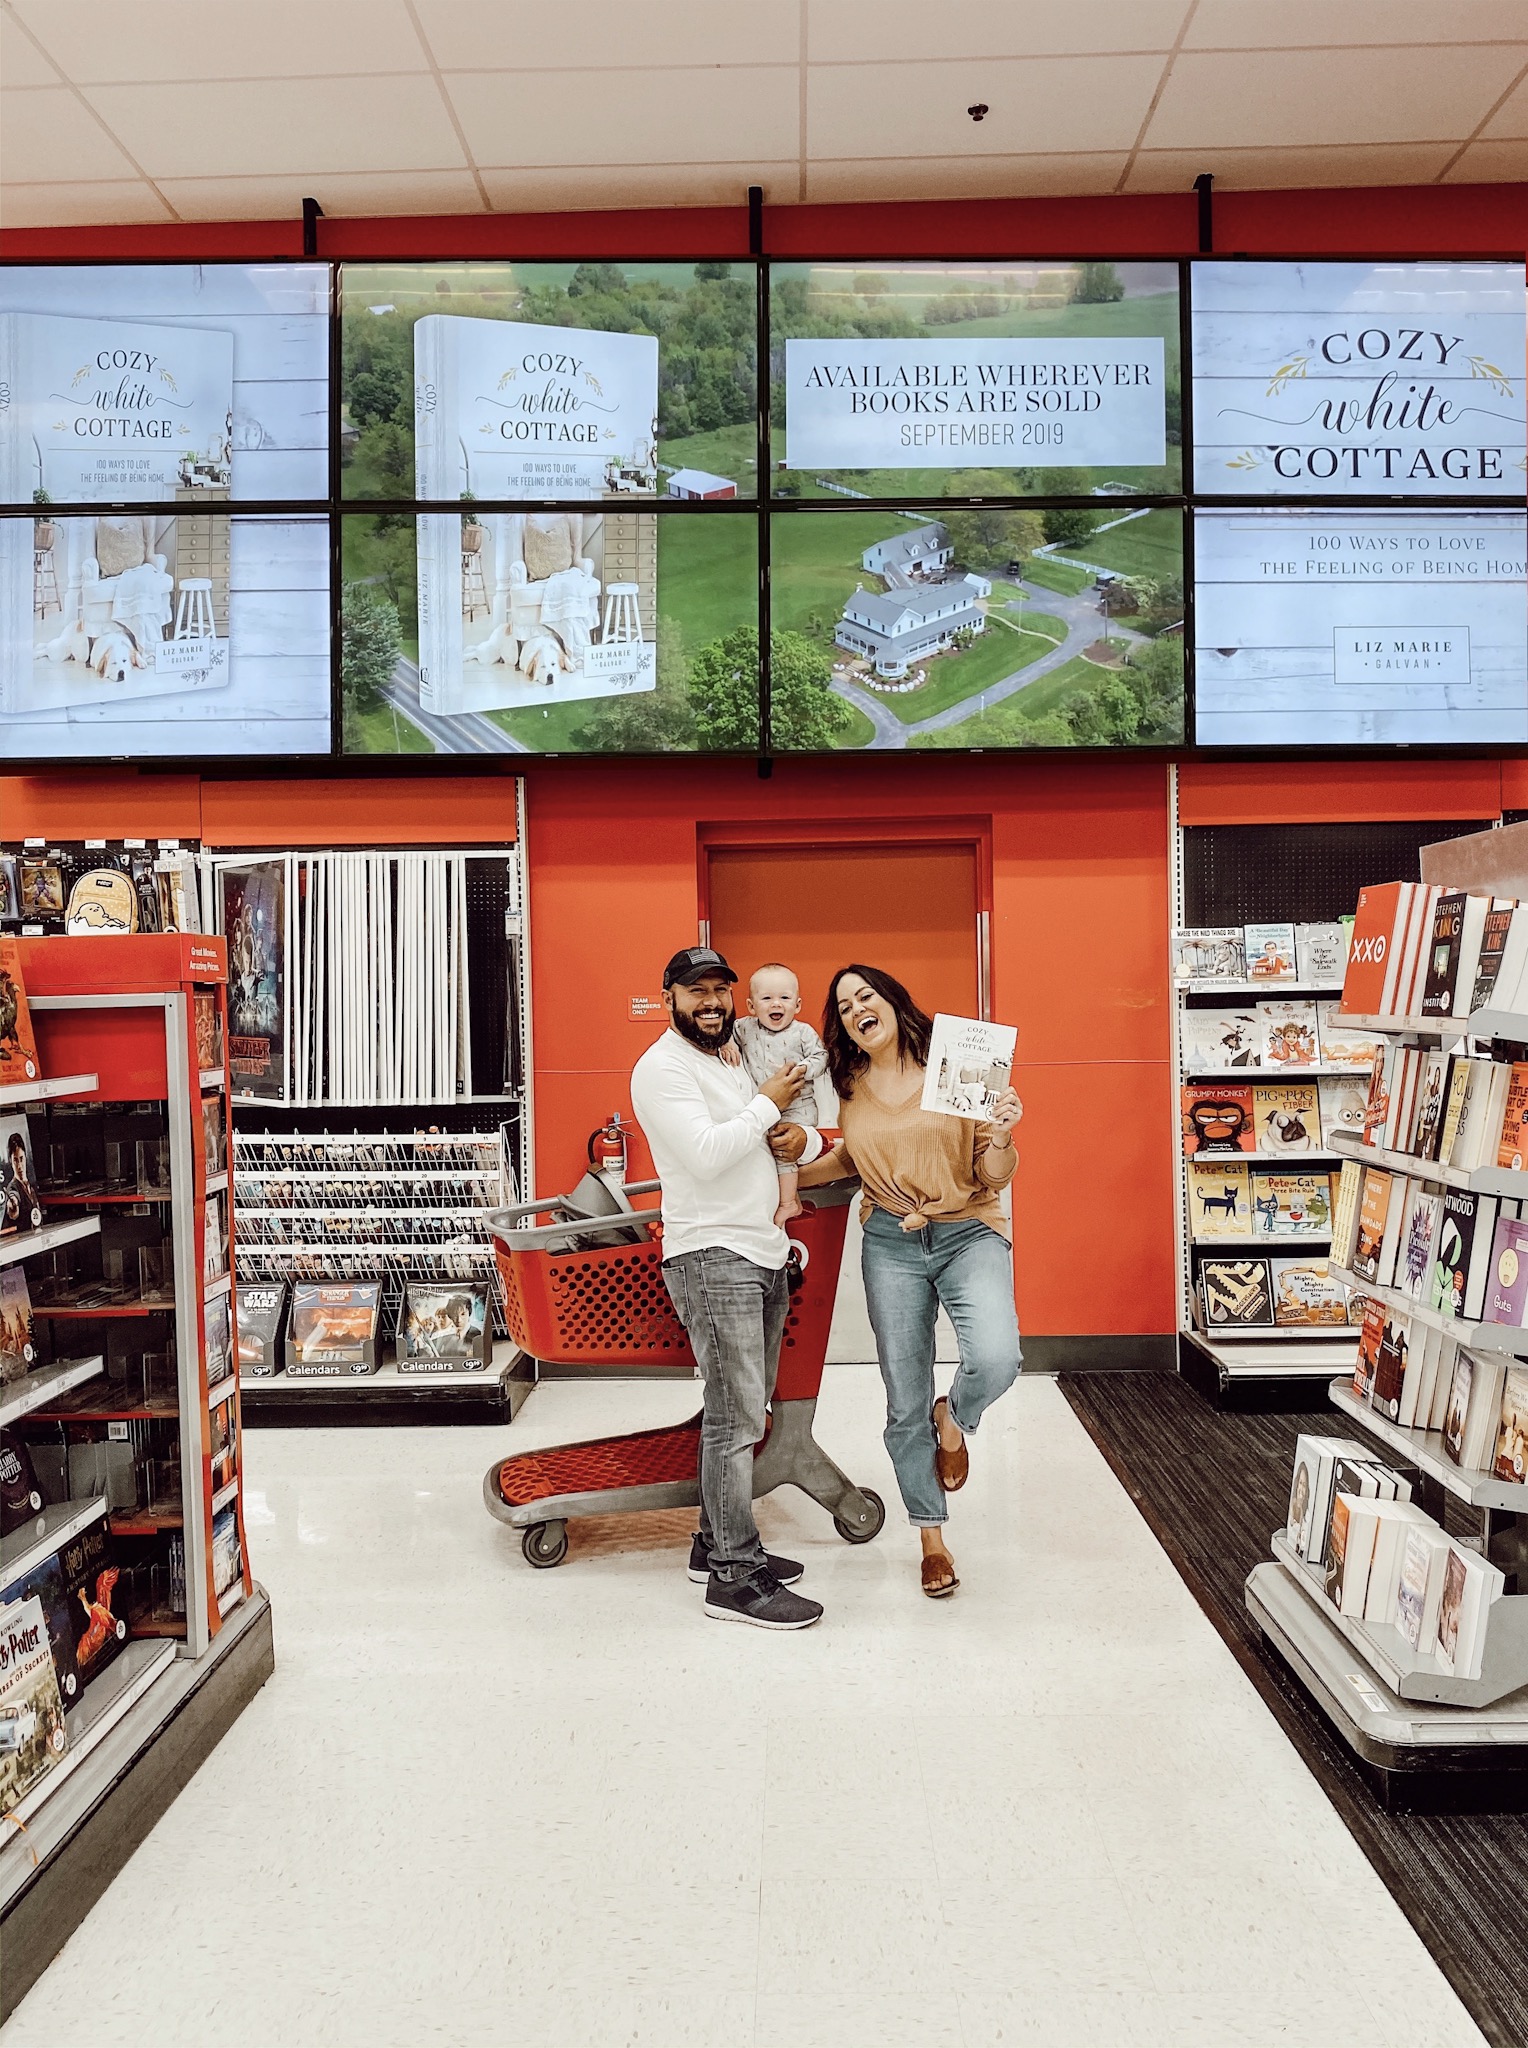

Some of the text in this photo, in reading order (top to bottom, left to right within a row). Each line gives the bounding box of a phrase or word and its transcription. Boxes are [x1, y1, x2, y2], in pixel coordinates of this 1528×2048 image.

[1321, 329, 1464, 366] COZY
[96, 349, 158, 373] COZY
[522, 353, 584, 377] COZY
[804, 363, 1152, 388] AVAILABLE WHEREVER
[68, 374, 176, 411] white
[495, 378, 602, 414] white
[425, 384, 436, 414] COZY
[850, 390, 1102, 414] BOOKS ARE SOLD
[1260, 370, 1495, 434] white
[74, 417, 172, 438] COTTAGE
[500, 420, 598, 443] COTTAGE
[900, 422, 1064, 447] SEPTEMBER 2019
[96, 460, 150, 469] 100 WAYS TO LOVE
[522, 463, 577, 473] 100 WAYS TO LOVE
[1274, 447, 1503, 480] COTTAGE
[80, 473, 164, 483] THE FEELING OF BEING HOME
[507, 477, 591, 487] THE FEELING OF BEING HOME
[1308, 536, 1342, 550] 100
[163, 645, 204, 656] LIZ MARIE
[1354, 641, 1453, 653] LIZ MARIE
[590, 649, 631, 660] LIZ MARIE
[1375, 659, 1430, 669] GALVAN
[1436, 902, 1462, 916] STEPHEN
[1433, 916, 1460, 938] KING
[967, 1026, 989, 1035] COZY
[957, 1042, 992, 1053] COTTAGE
[1216, 1090, 1248, 1098] MONKEY
[1255, 1089, 1313, 1101] PIG PUG
[1282, 1101, 1314, 1110] FIBBER
[1194, 1165, 1243, 1174] Pete Cat
[1268, 1177, 1315, 1187] Pete Cat
[1368, 1182, 1383, 1194] WHERE
[1368, 1200, 1377, 1210] THE
[246, 1291, 278, 1300] STAR
[243, 1299, 277, 1308] WARS
[1493, 1295, 1512, 1313] Guts
[287, 1366, 340, 1375] Calendars
[401, 1361, 453, 1371] Calendars
[9, 1625, 41, 1666] Potter
